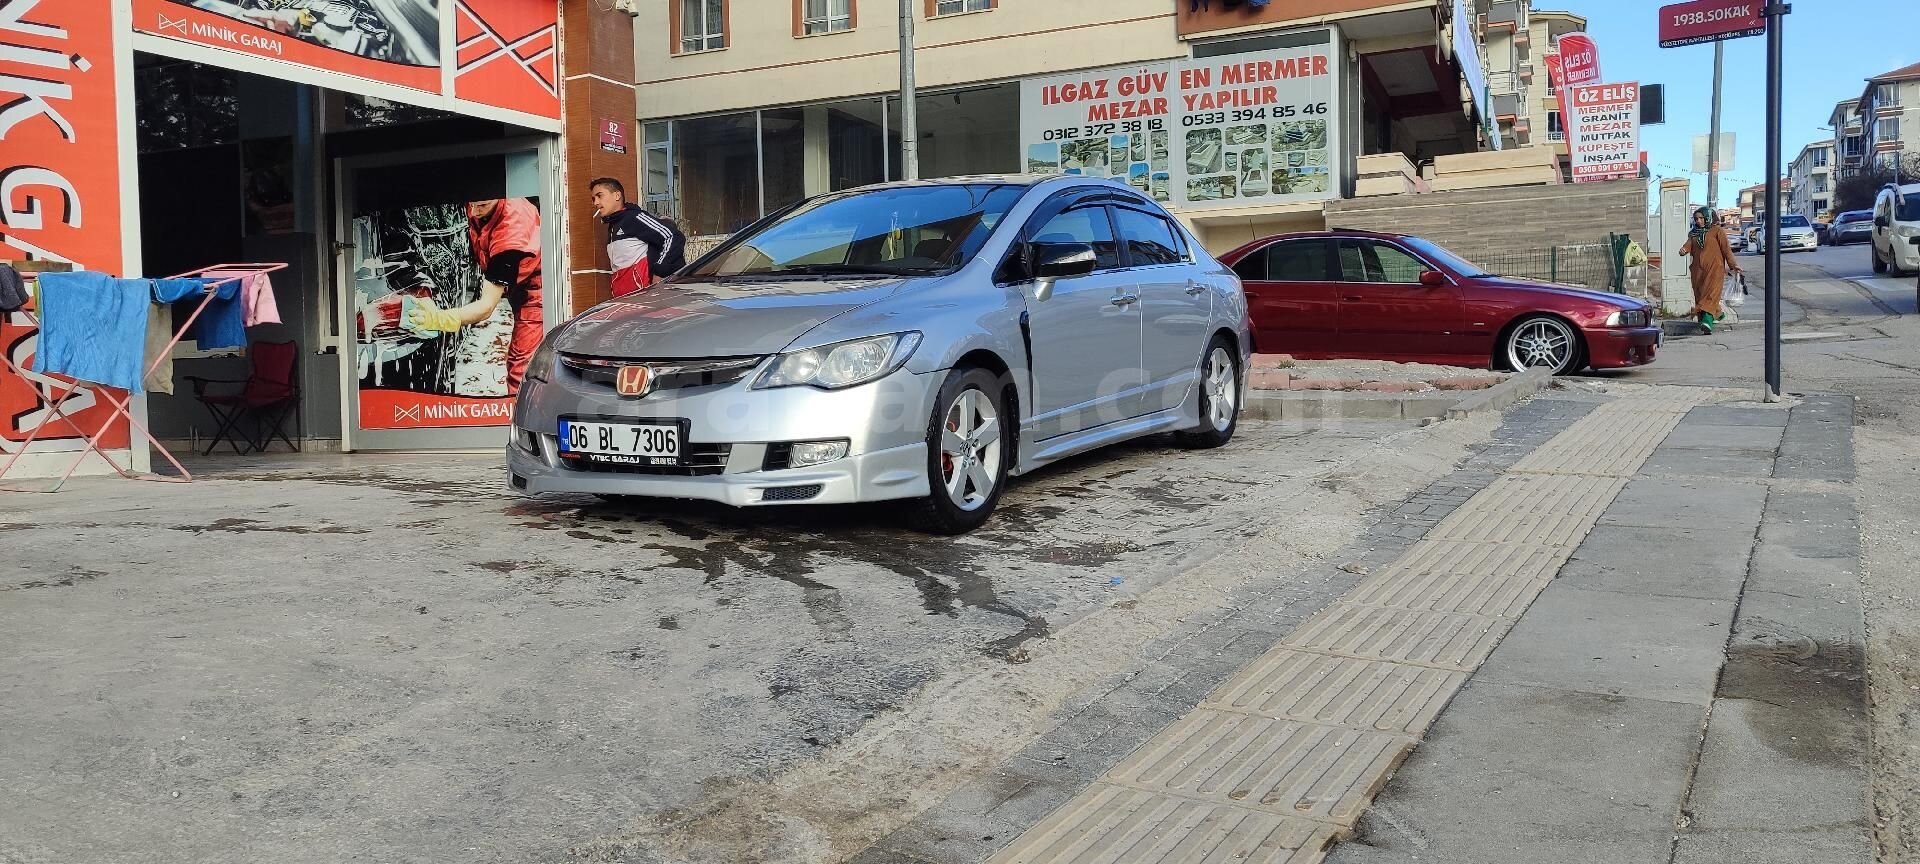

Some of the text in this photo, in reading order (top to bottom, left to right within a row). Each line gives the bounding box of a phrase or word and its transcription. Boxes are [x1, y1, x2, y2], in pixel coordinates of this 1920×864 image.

[1673, 4, 1751, 27] 1938.SOKAK
[192, 21, 282, 55] MİNİK GARAJ
[1042, 79, 1109, 105] ILGAZ
[1220, 55, 1328, 86] MERMER
[1087, 85, 1278, 122] MEZAR YAPILIR
[1578, 84, 1635, 103] ÖZ ELİŞ
[1578, 103, 1633, 115] MERMER
[1581, 112, 1631, 123] GRANİT
[608, 121, 618, 134] 82
[1043, 102, 1328, 141] 0312 372 38 18 0533 394 85 46
[1579, 121, 1632, 133] MEZAR
[1580, 131, 1631, 142] MUTFAK
[424, 401, 513, 421] MİNİK GARAJ
[569, 424, 588, 449] 06
[599, 426, 620, 451] BL
[631, 427, 676, 453] 7306
